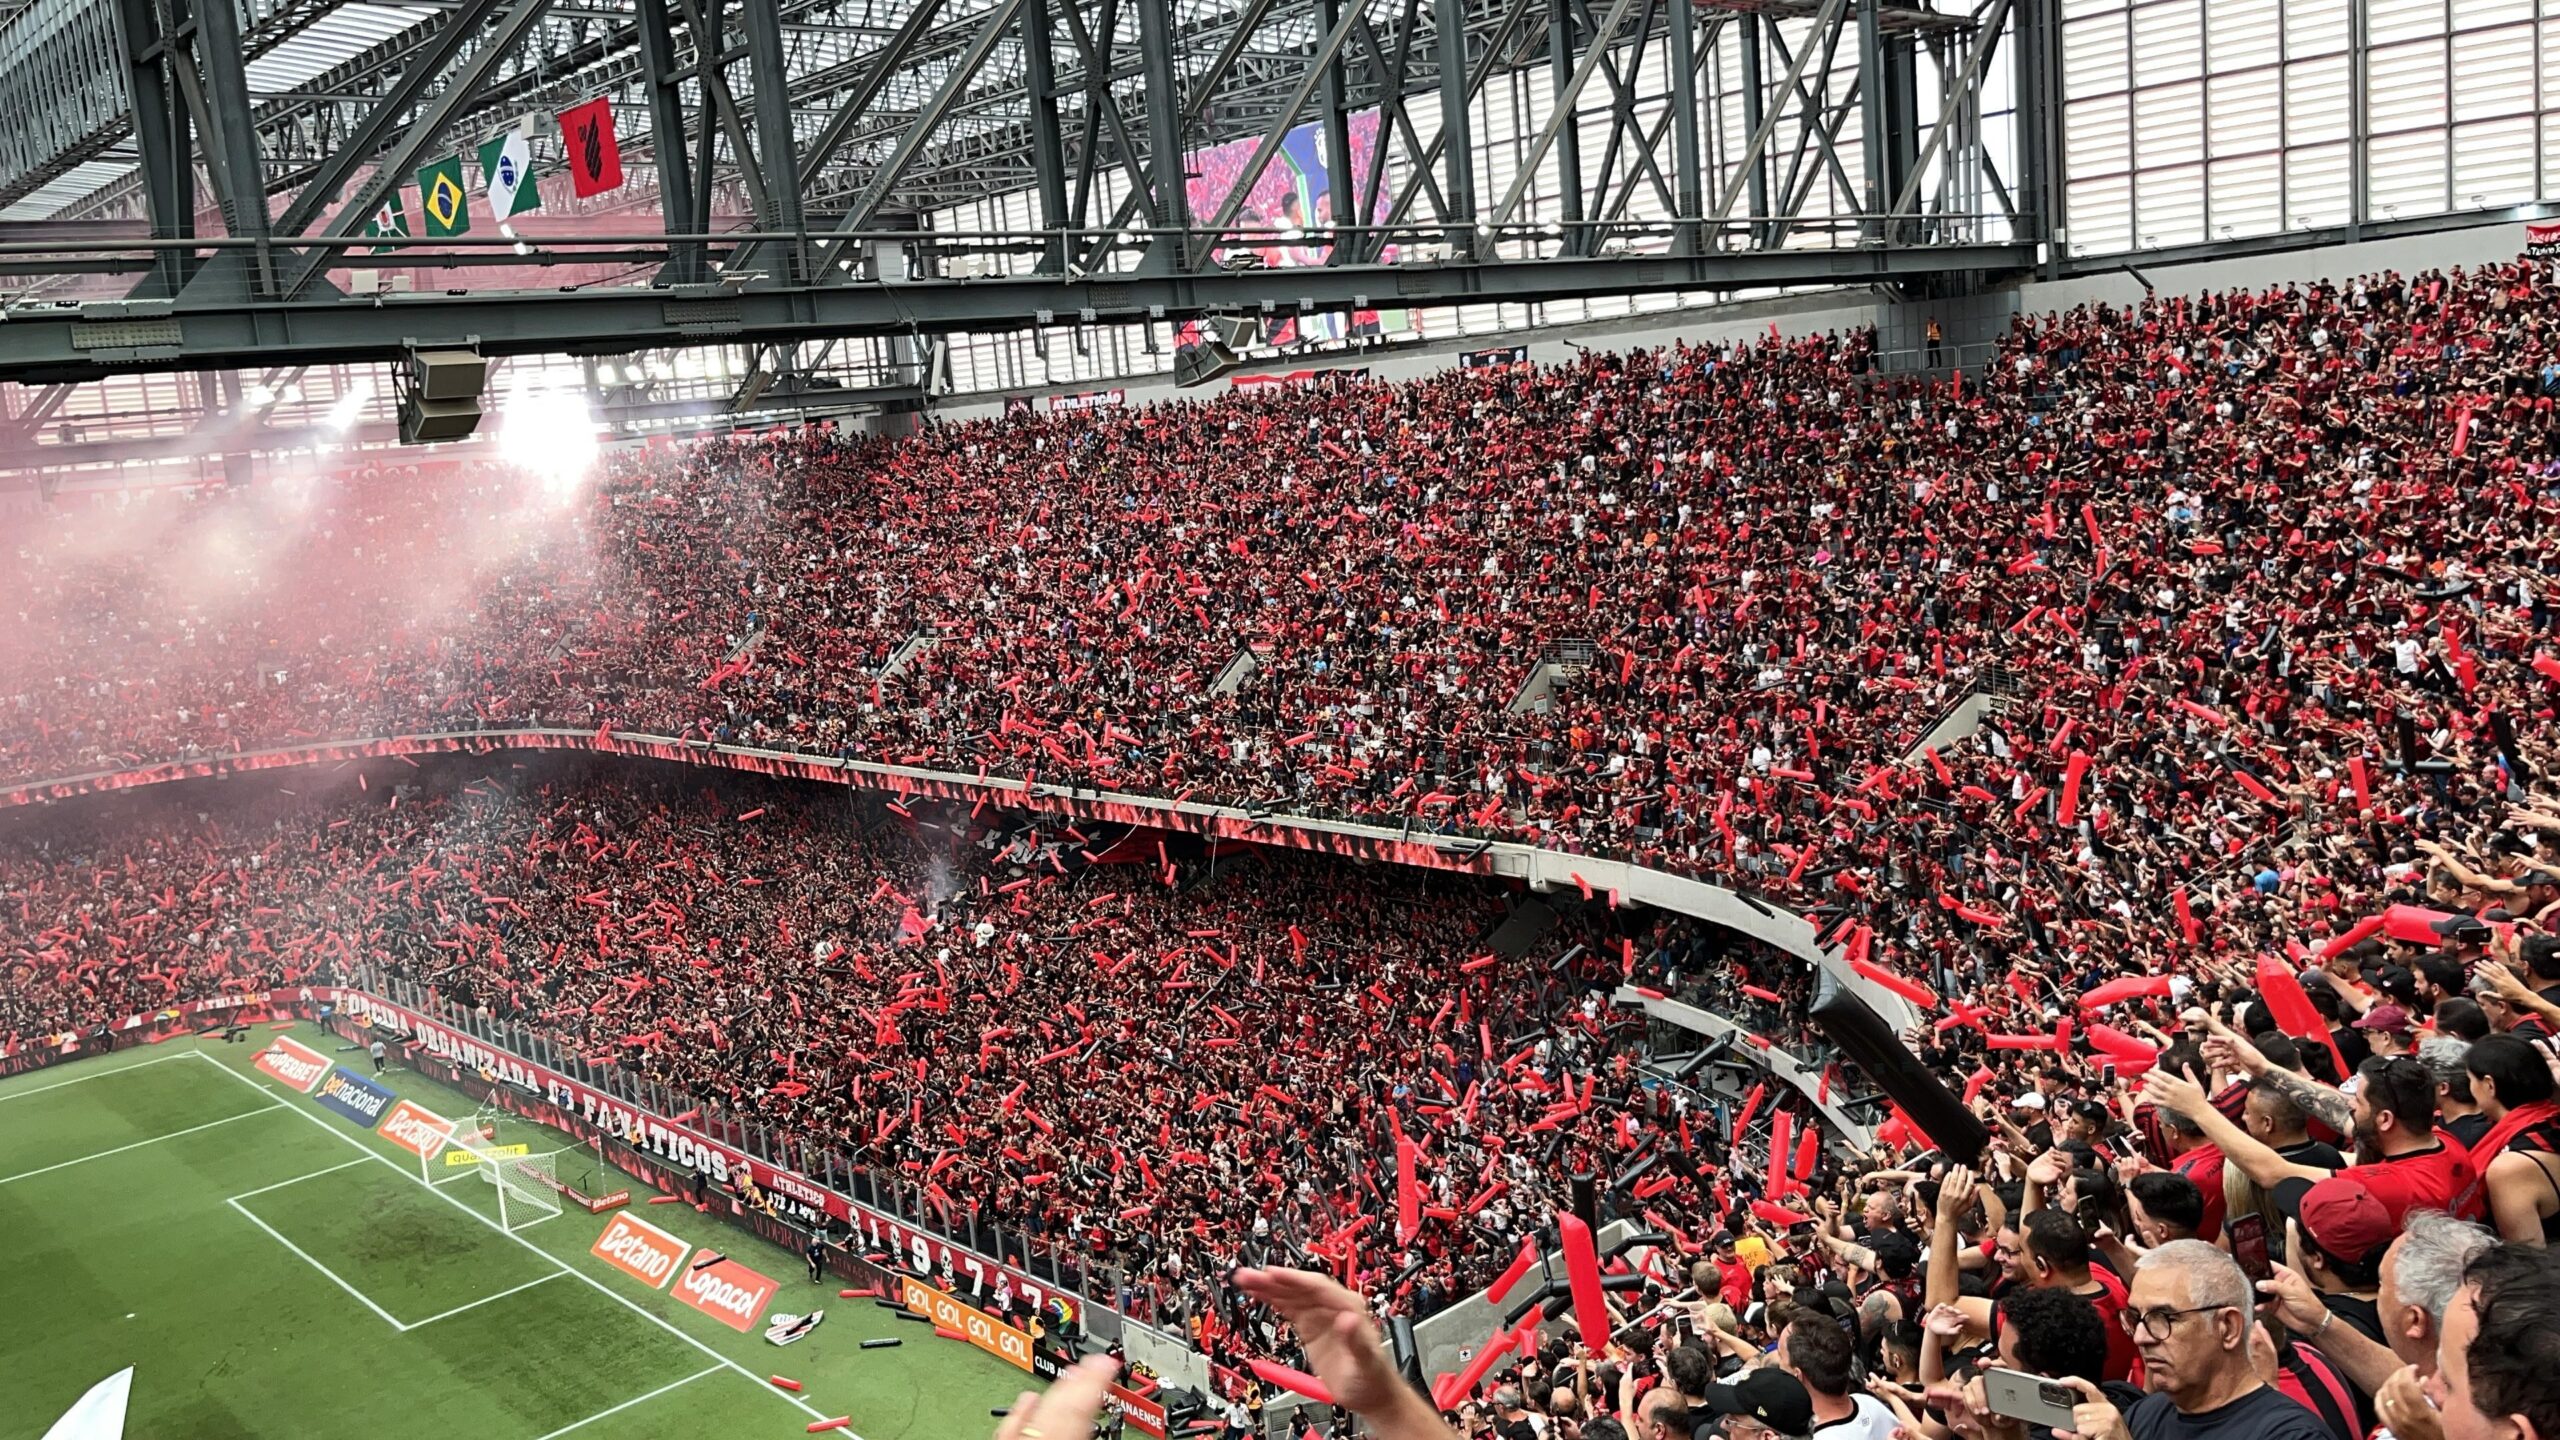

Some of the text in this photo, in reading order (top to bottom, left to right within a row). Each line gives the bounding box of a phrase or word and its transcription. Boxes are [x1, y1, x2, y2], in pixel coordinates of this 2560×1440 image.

[196, 991, 271, 1012] ATHLETCO
[264, 1043, 322, 1082] SUPERBET
[323, 1072, 387, 1117] betnacional
[331, 990, 411, 1035] TORCIDA
[415, 1021, 541, 1093] ORGANIZADA
[583, 1092, 729, 1182] FANÁTICOS
[384, 1109, 440, 1150] Betano
[773, 1173, 825, 1207] ATHLETICO
[787, 1200, 796, 1214] A
[599, 1222, 670, 1278] Betano
[684, 1257, 765, 1319] Copacol
[906, 1284, 1028, 1362] GOL GOL GOL GOL
[1034, 1355, 1055, 1374] CLUB
[1102, 1390, 1163, 1430] PAANAENSE
